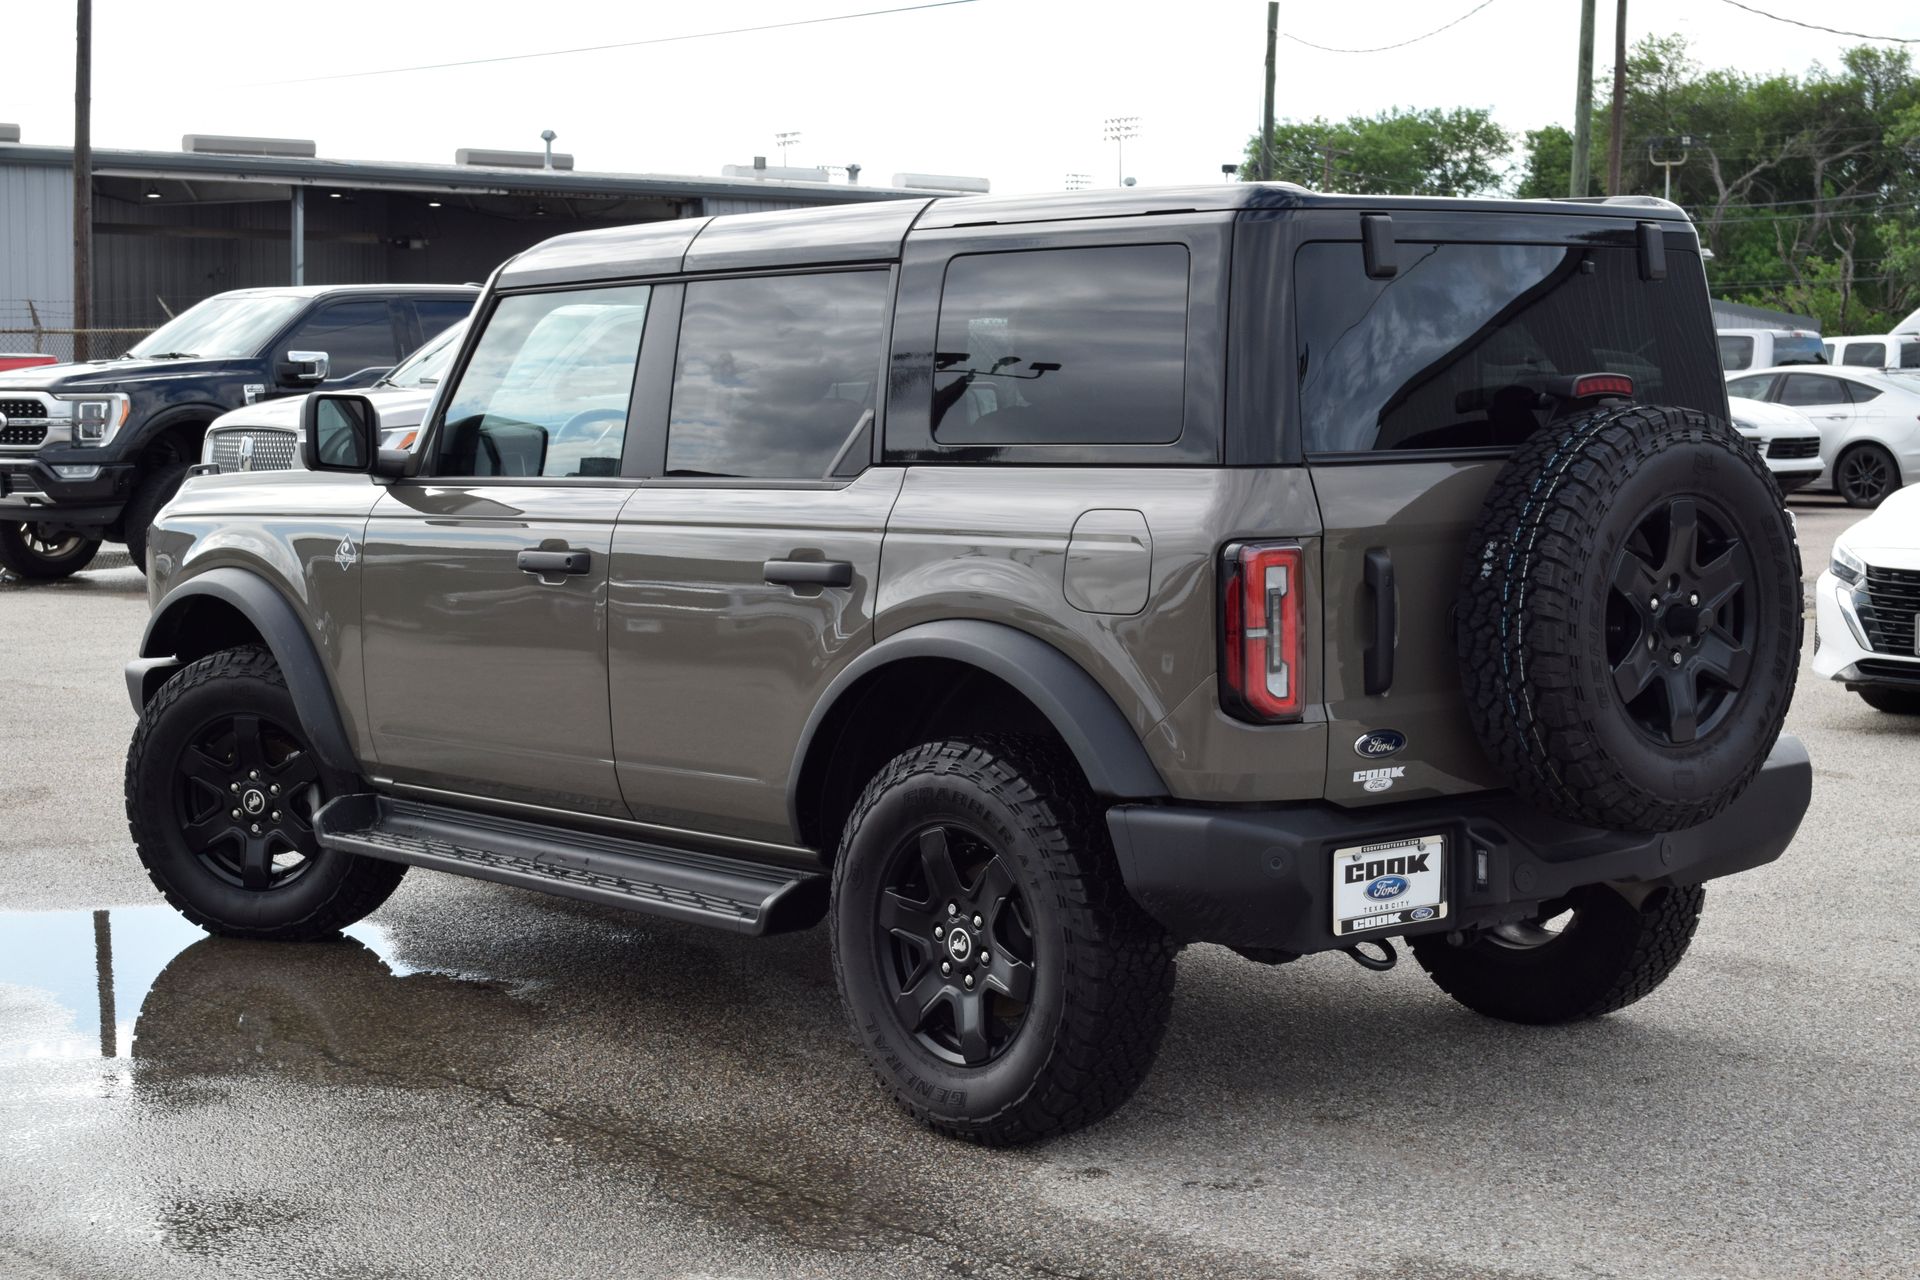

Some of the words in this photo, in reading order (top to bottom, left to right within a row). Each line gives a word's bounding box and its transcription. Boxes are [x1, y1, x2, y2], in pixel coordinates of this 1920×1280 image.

[1368, 735, 1395, 753] Ford
[1353, 766, 1406, 782] COOK
[1345, 853, 1430, 884] COOK
[1373, 880, 1401, 897] Ford
[1364, 903, 1389, 914] TEXAS
[1392, 900, 1410, 909] CITY
[1353, 913, 1402, 930] COOK
